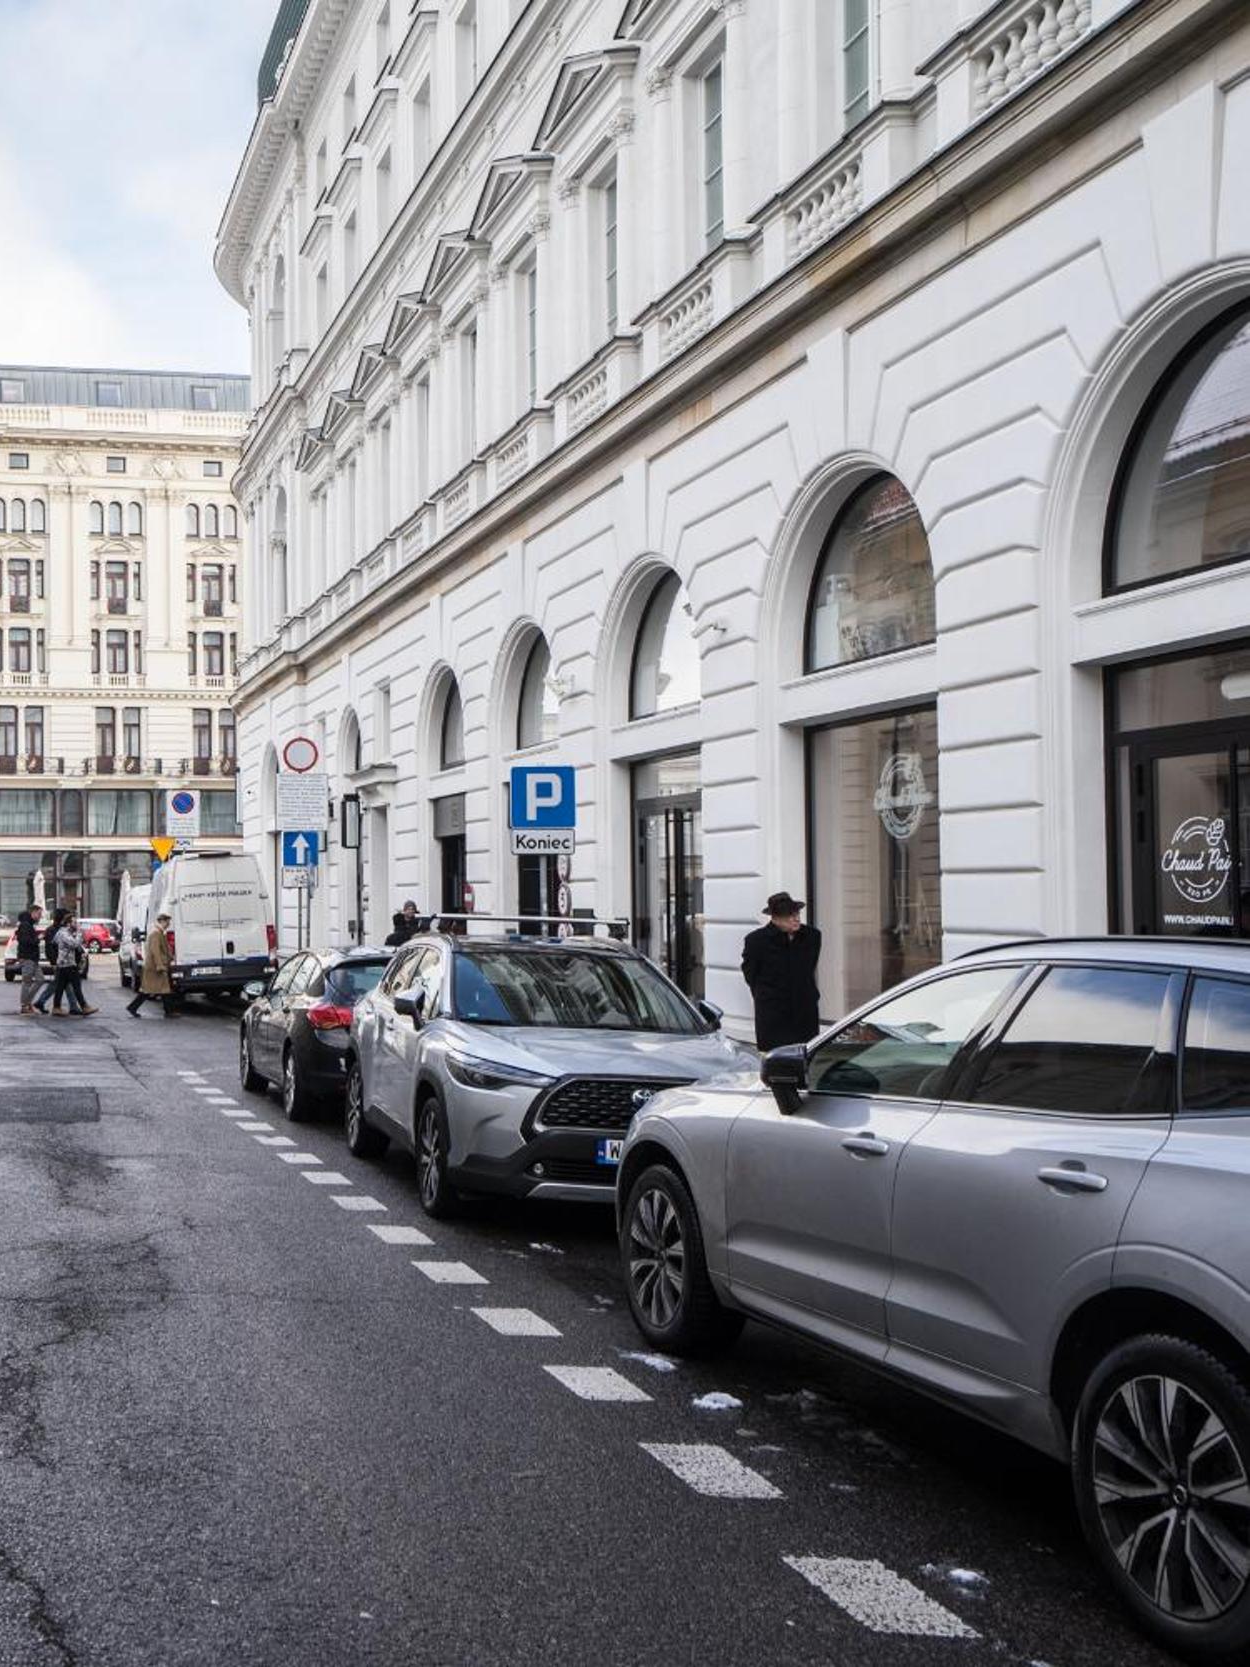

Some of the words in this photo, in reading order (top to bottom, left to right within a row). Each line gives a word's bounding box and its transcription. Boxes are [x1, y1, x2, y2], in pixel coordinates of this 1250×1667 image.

[526, 773, 562, 821] P
[516, 834, 570, 849] Koniec
[1161, 849, 1204, 872] Chaud
